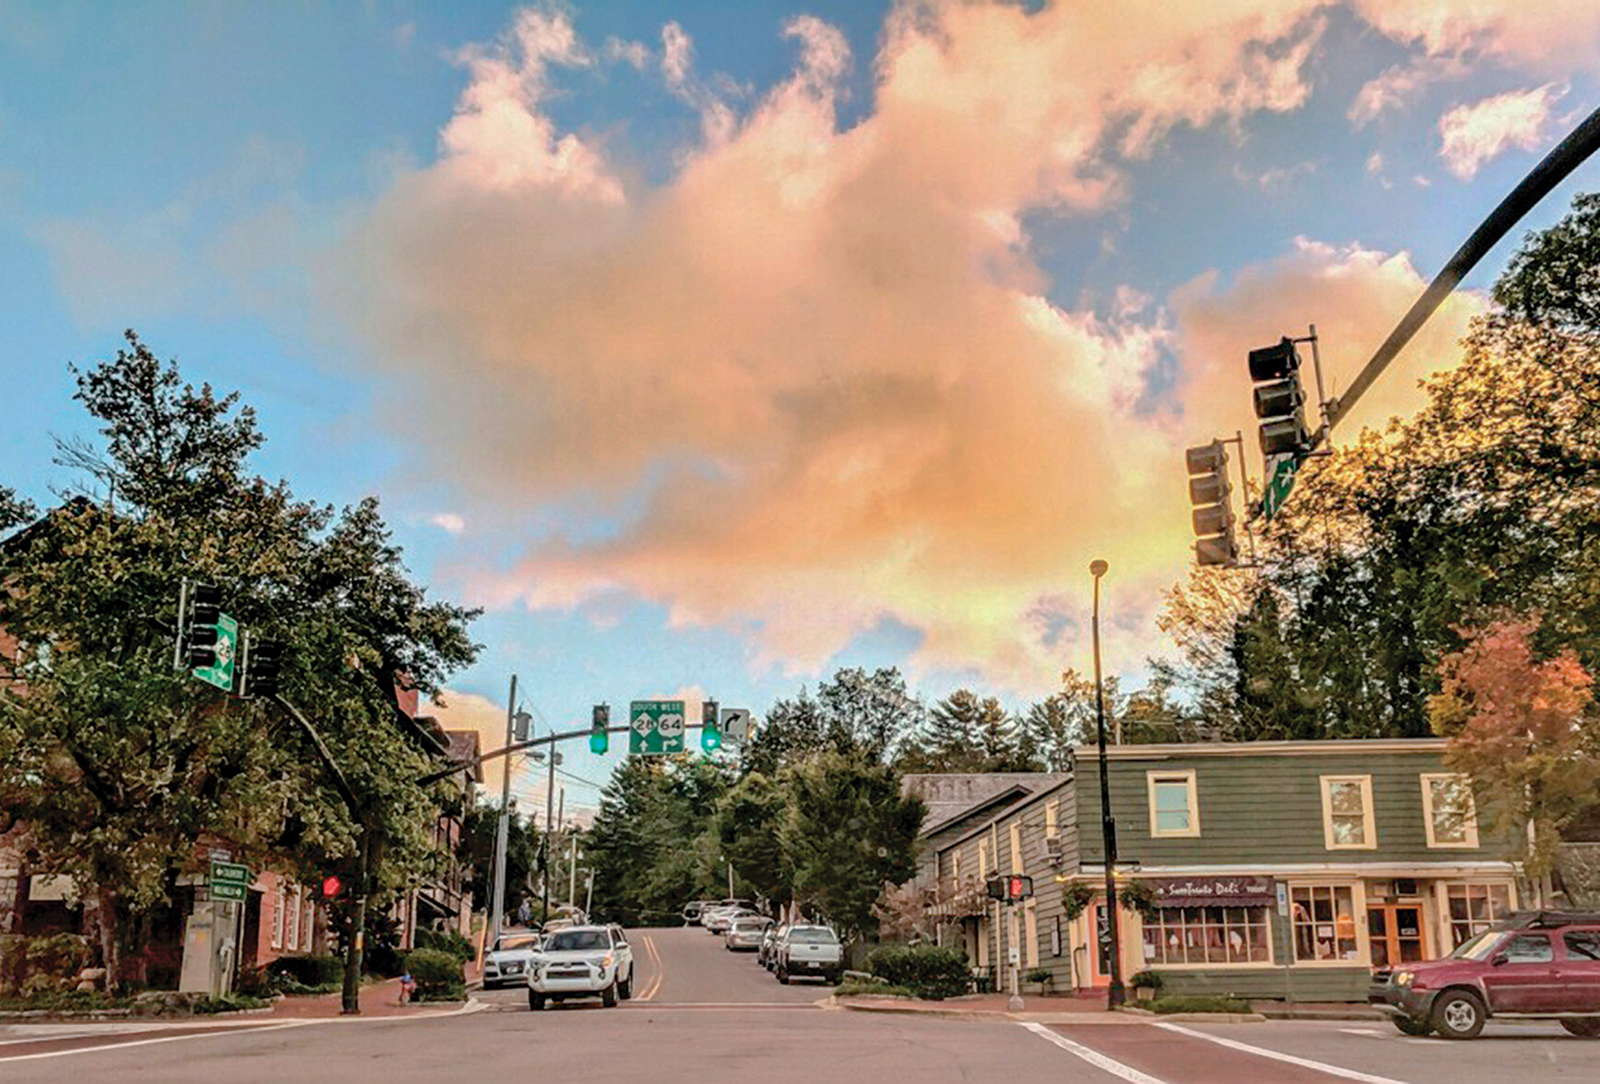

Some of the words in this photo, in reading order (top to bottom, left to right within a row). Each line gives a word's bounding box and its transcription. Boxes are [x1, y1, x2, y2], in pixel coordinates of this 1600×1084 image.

[636, 719, 654, 731] 28
[660, 719, 681, 731] 64
[1215, 882, 1240, 895] Deli
